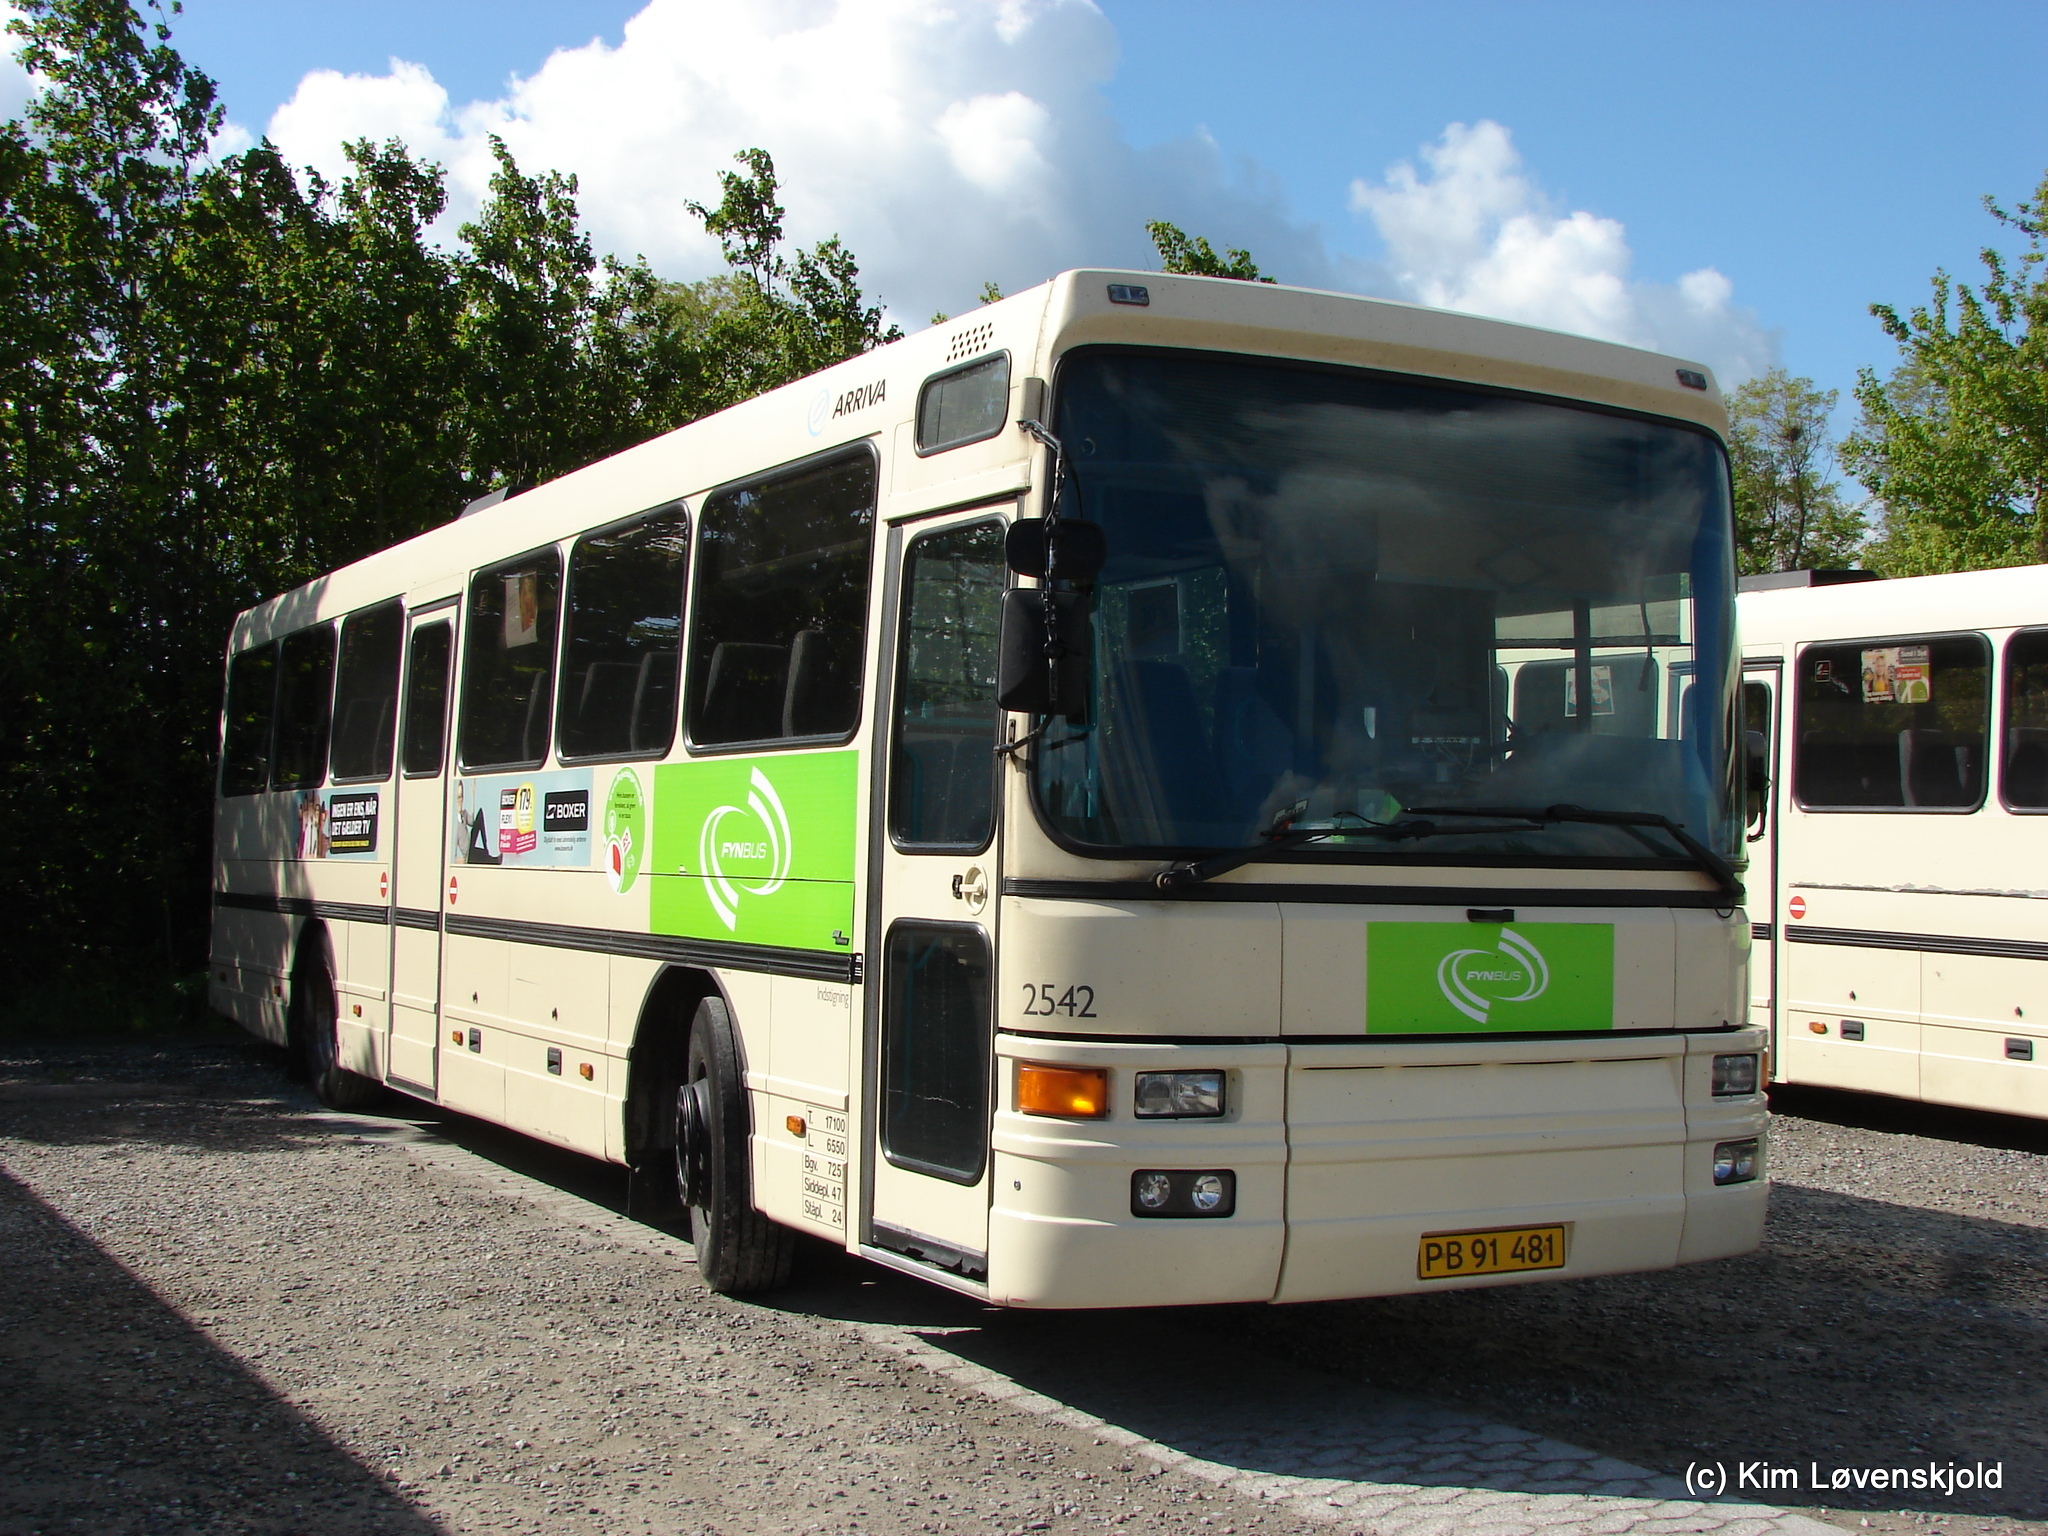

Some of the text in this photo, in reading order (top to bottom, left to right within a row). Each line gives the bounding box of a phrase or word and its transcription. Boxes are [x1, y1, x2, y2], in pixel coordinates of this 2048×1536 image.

[832, 379, 886, 420] ARRIVA
[556, 802, 586, 819] BOXER
[332, 821, 341, 836] DET
[362, 819, 371, 834] TV
[721, 842, 767, 859] FYNBUS
[1466, 970, 1522, 981] FYNBUS
[817, 986, 849, 1009] Indstigning
[1022, 983, 1097, 1018] 2542
[825, 1116, 845, 1133] 17100
[808, 1133, 845, 1155] L 6550
[804, 1155, 842, 1177] Bgv. 725
[804, 1177, 842, 1201] Siddepl. 47
[804, 1200, 842, 1225] Ståpl. 24
[1426, 1234, 1553, 1272] PB 91 481
